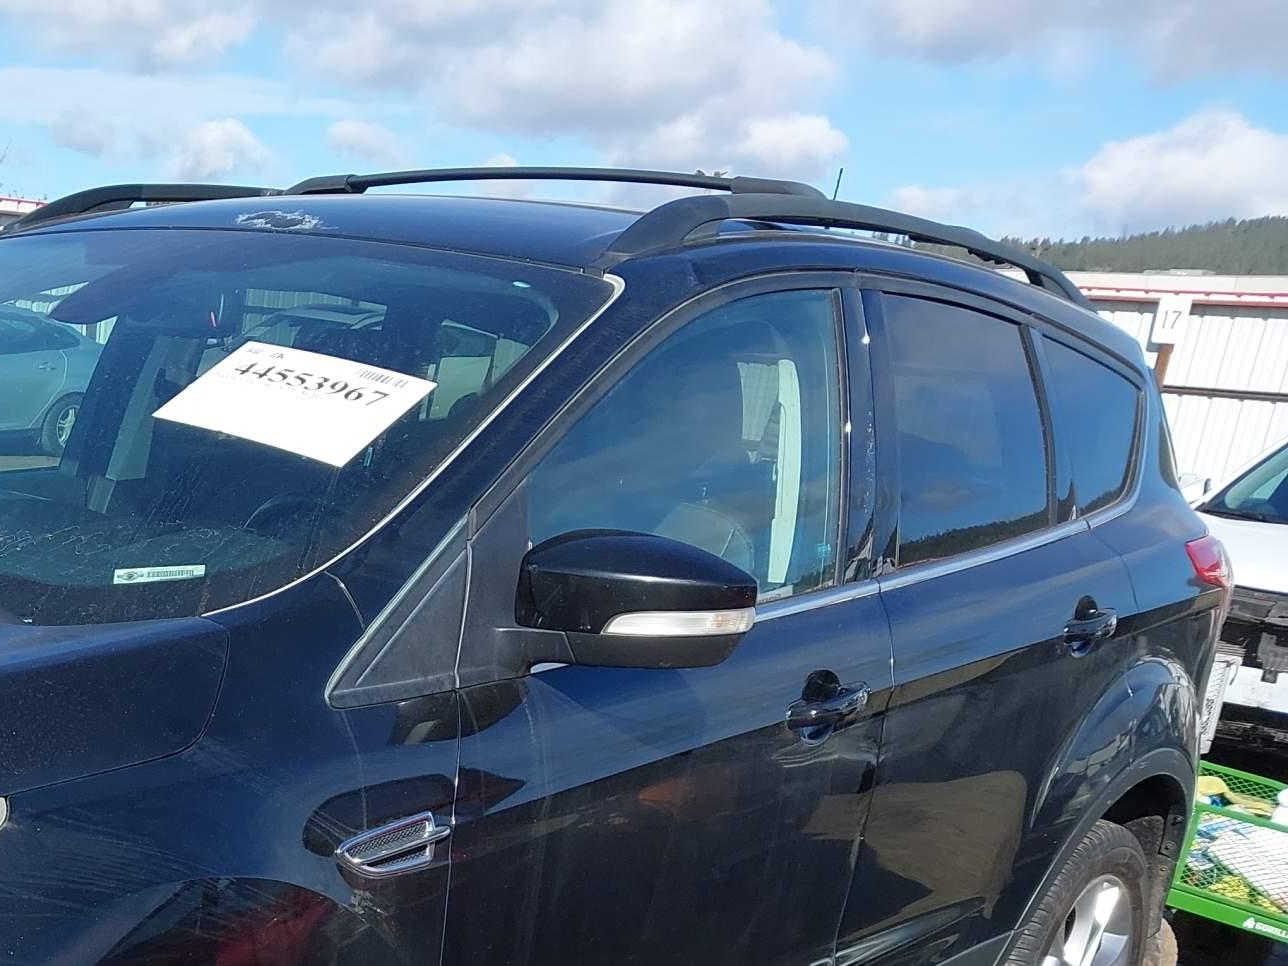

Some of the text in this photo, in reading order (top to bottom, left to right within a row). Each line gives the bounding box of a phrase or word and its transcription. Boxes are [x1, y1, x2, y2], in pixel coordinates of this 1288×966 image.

[1162, 310, 1182, 329] 17
[235, 362, 390, 406] 44553967
[1255, 922, 1288, 938] GORILL
